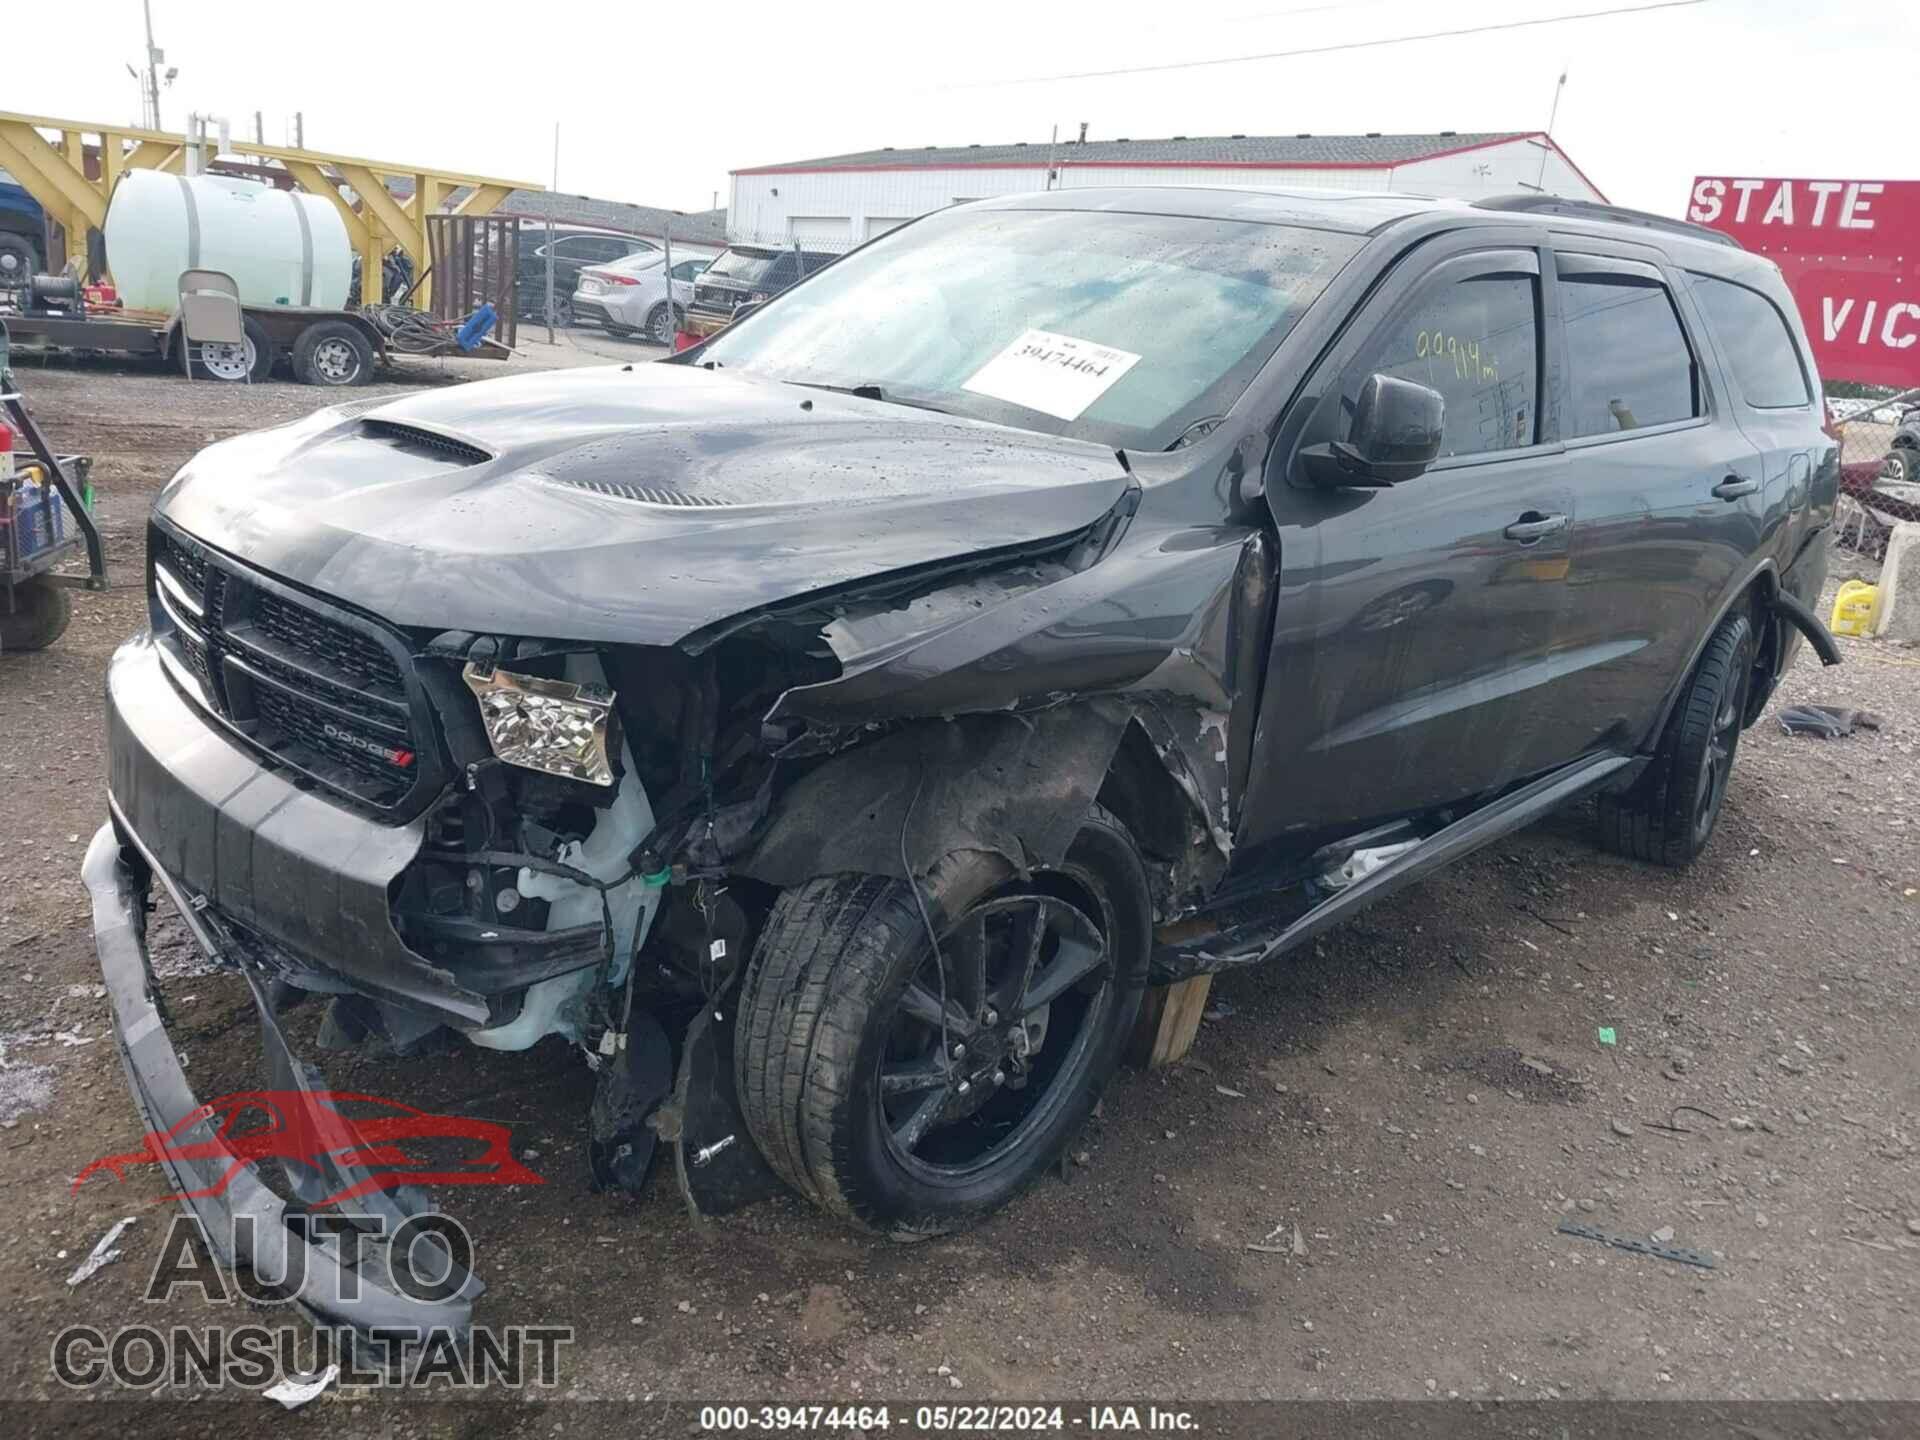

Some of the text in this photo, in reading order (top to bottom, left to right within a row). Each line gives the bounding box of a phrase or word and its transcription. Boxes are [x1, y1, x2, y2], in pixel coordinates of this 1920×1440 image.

[1690, 179, 1884, 229] STATE
[1822, 296, 1920, 348] VIC
[1013, 344, 1109, 377] 39474464
[324, 724, 398, 762] DODGE
